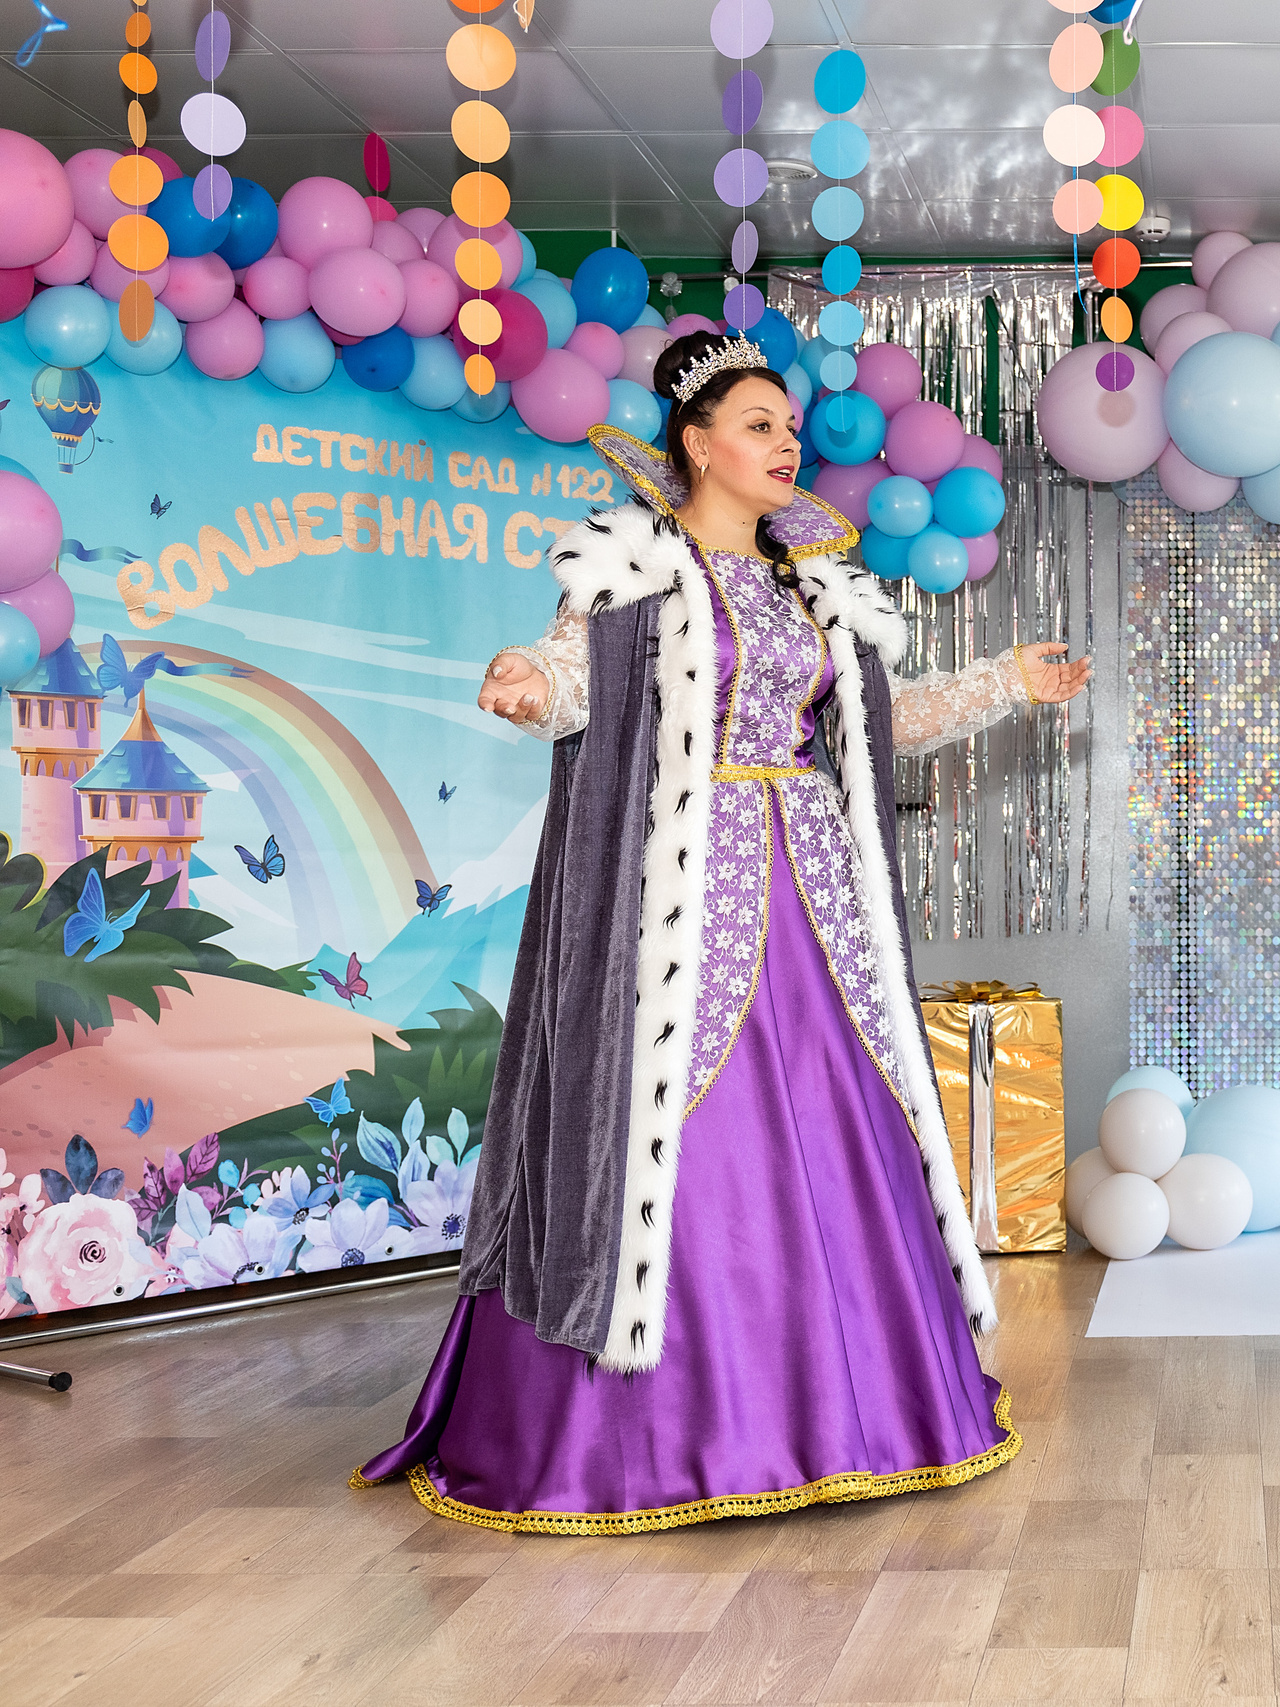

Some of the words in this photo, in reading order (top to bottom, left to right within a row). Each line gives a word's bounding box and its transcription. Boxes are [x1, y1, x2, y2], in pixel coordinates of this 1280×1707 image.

[252, 423, 434, 483] ДЕТСКИЙ
[448, 451, 520, 495] САД
[116, 491, 488, 630] ВОЛШЕБНАЯ
